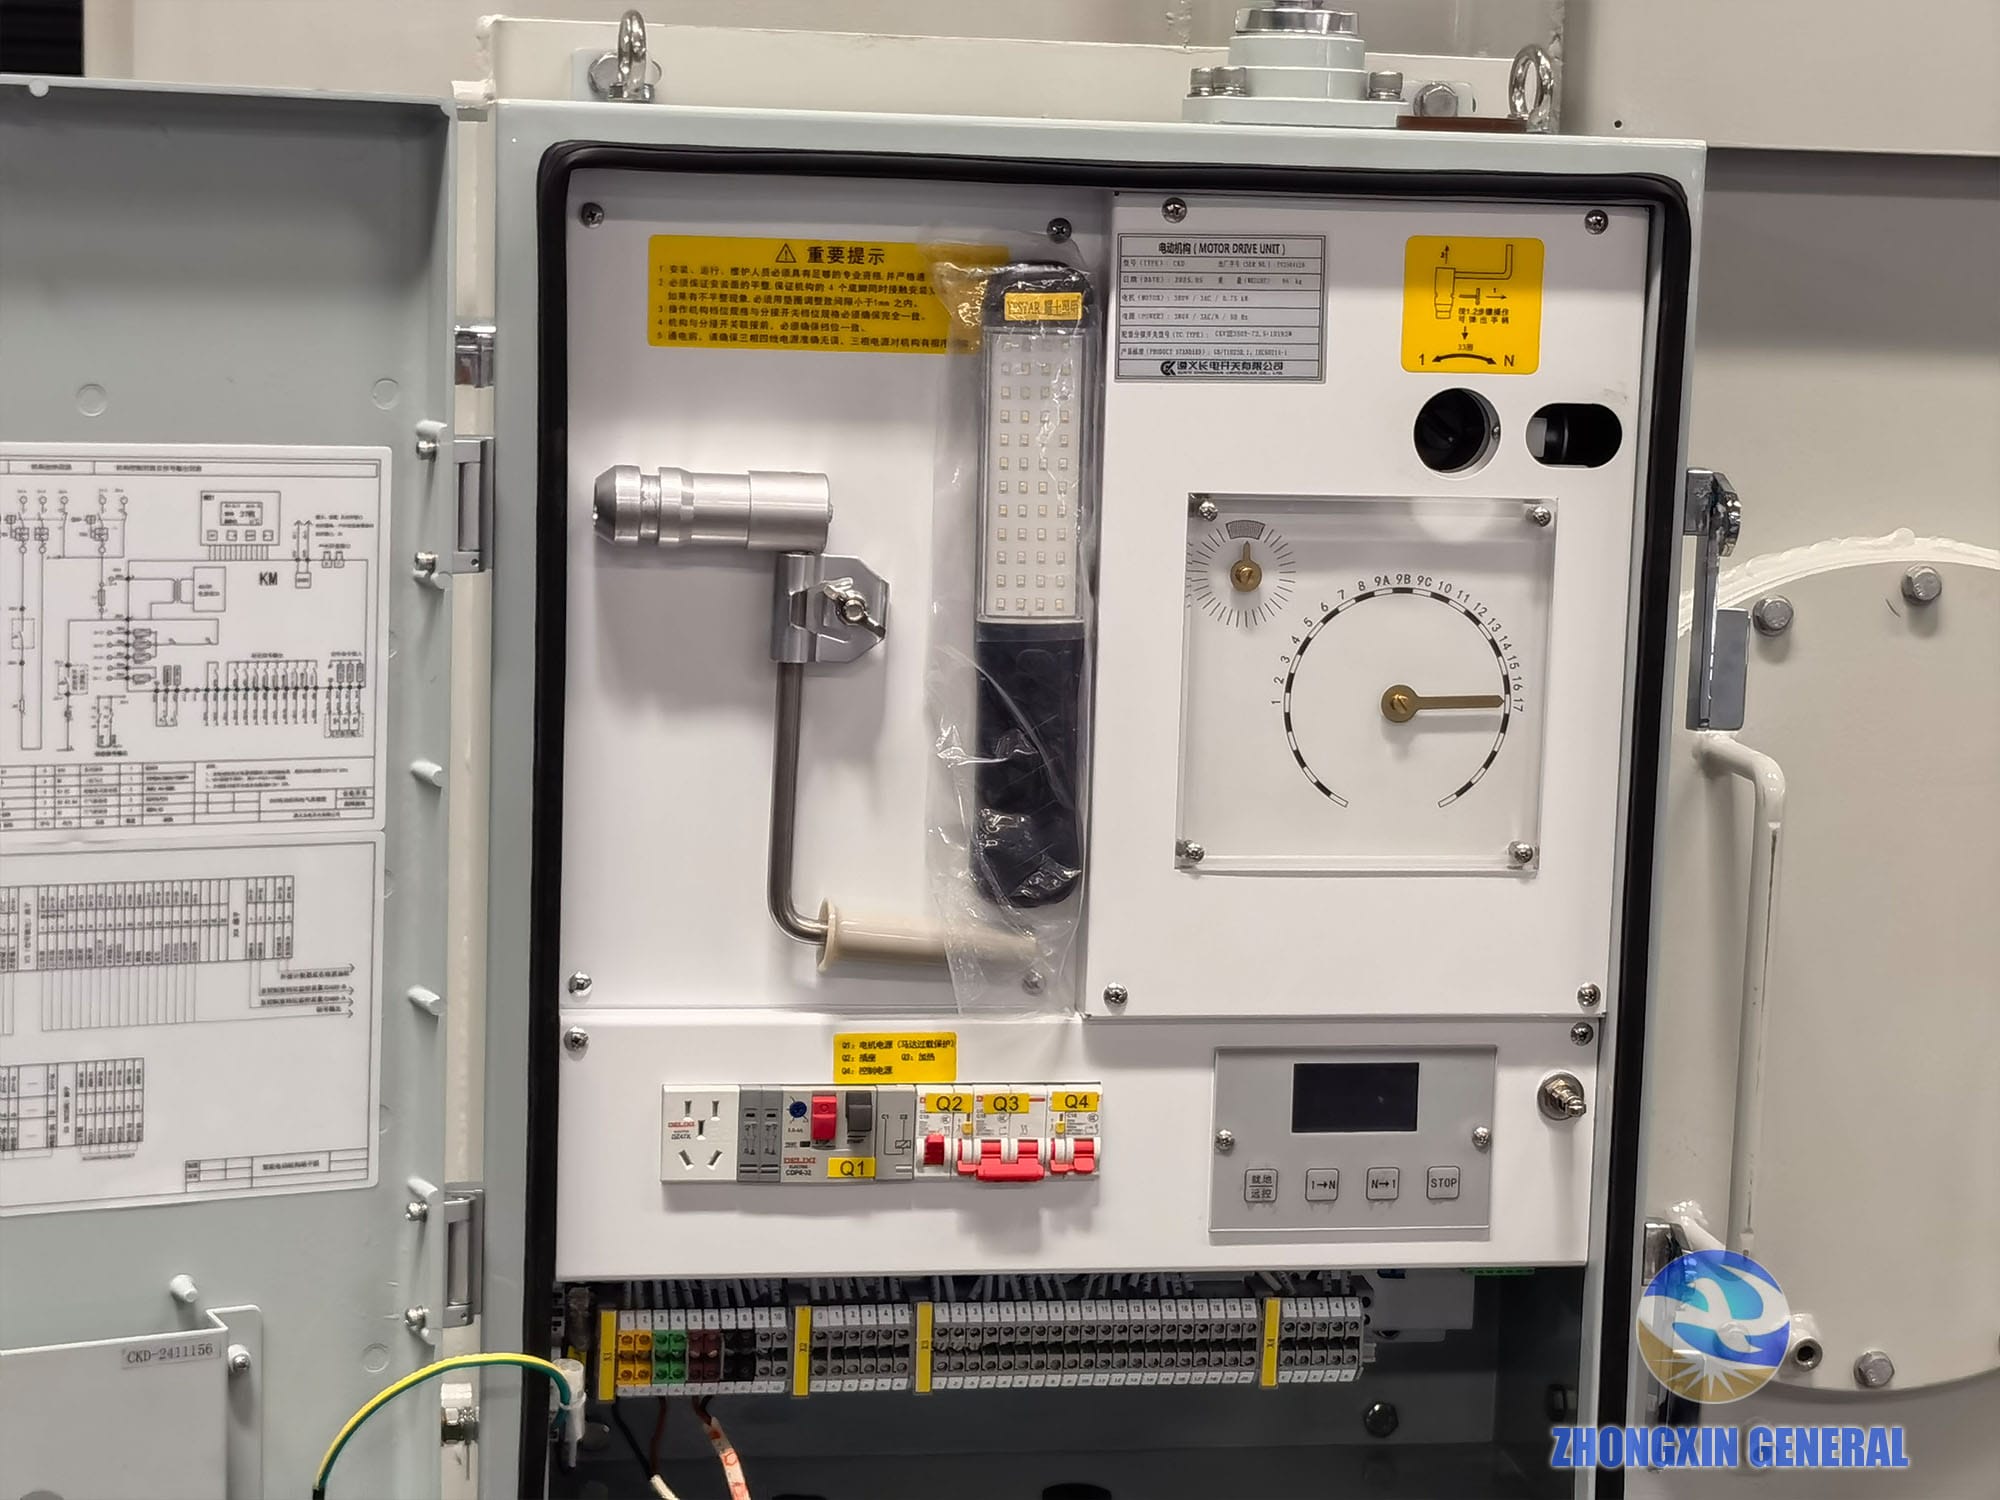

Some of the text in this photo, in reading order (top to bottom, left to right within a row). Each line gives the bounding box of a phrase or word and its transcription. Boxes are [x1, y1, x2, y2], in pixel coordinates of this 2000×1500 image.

[807, 246, 885, 266] 重要提示
[1232, 244, 1257, 255] DRIVE
[1418, 354, 1515, 367] 1 N
[259, 572, 278, 586] KM
[1373, 576, 1391, 587] 9A
[1395, 573, 1412, 585] 9B
[1416, 575, 1433, 587] 9C
[1357, 580, 1367, 592] 8
[1437, 581, 1453, 594] 10
[1337, 589, 1345, 600] 7
[1456, 589, 1471, 603] 11
[1320, 601, 1329, 613] 6
[1472, 602, 1488, 618] 12
[1303, 616, 1314, 628] 5
[1486, 616, 1501, 633] 13
[1290, 635, 1301, 646] 4
[1498, 635, 1513, 651] 14
[1280, 654, 1291, 665] 3
[1506, 654, 1520, 670] 15
[1273, 675, 1285, 685] 2
[1511, 675, 1523, 691] 16
[1512, 697, 1524, 713] 17
[936, 1096, 962, 1112] Q2
[993, 1096, 1019, 1112] Q3
[1065, 1094, 1088, 1109] Q4
[840, 1160, 865, 1177] Q1
[1251, 1174, 1272, 1185] 就地
[1430, 1178, 1457, 1188] STOP
[1251, 1188, 1272, 1199] 远控
[127, 1343, 214, 1364] CKD-2411156
